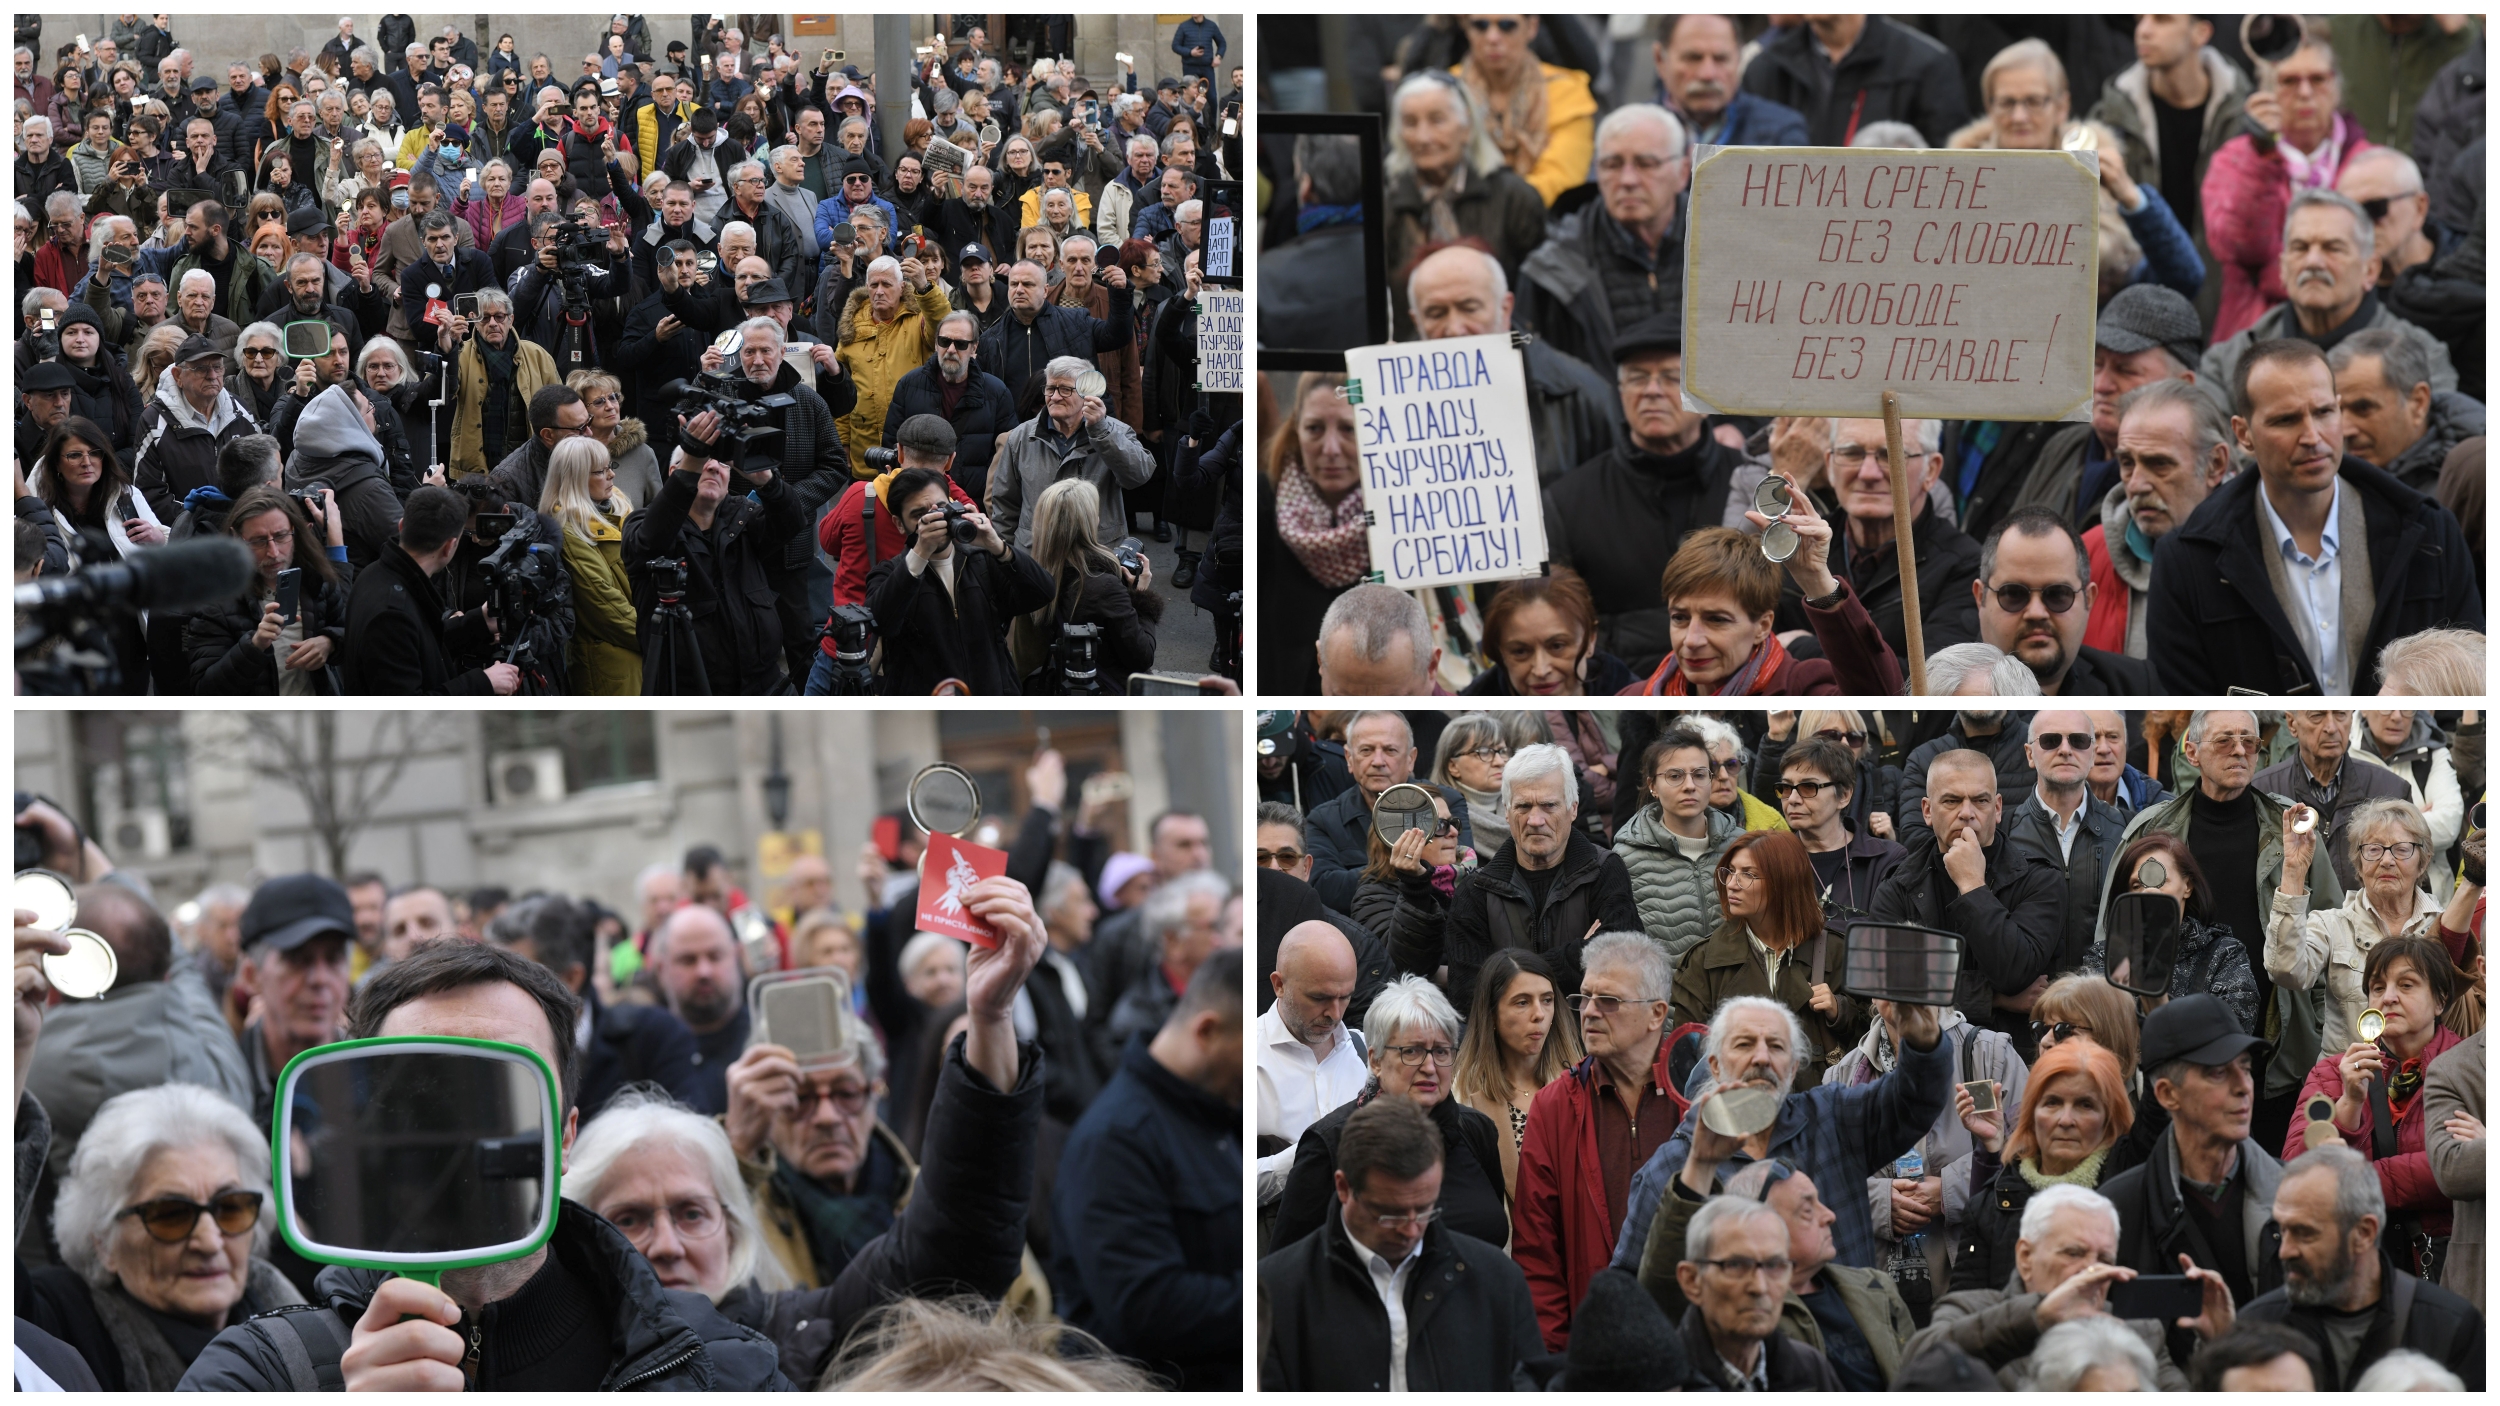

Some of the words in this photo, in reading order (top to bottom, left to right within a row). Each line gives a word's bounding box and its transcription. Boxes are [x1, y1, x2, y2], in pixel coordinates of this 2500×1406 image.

[1741, 163, 1848, 208] НЕМА
[1863, 165, 1996, 210] СРЕЋЕ
[1818, 219, 1893, 264] БЕЗ
[1913, 221, 2086, 272] СЛОБОДЕ,
[1200, 316, 1213, 332] ЗА
[1218, 316, 1243, 332] ДАД
[1209, 296, 1243, 313] ПРАВ
[1727, 279, 1782, 324] НИ
[1799, 281, 1969, 328] СЛОБОДЕ
[1378, 349, 1492, 396] ПРАВДА
[1792, 335, 1866, 381] БЕЗ
[1359, 405, 1396, 446] ЗА
[1405, 398, 1484, 442] ДАДУ,
[1363, 438, 1514, 489] ЋУРУВИЈУ,
[1389, 486, 1487, 535] НАРОД
[1495, 484, 1519, 523] И
[1393, 527, 1522, 580] СРБИЈУ!
[921, 913, 932, 922] НЕ
